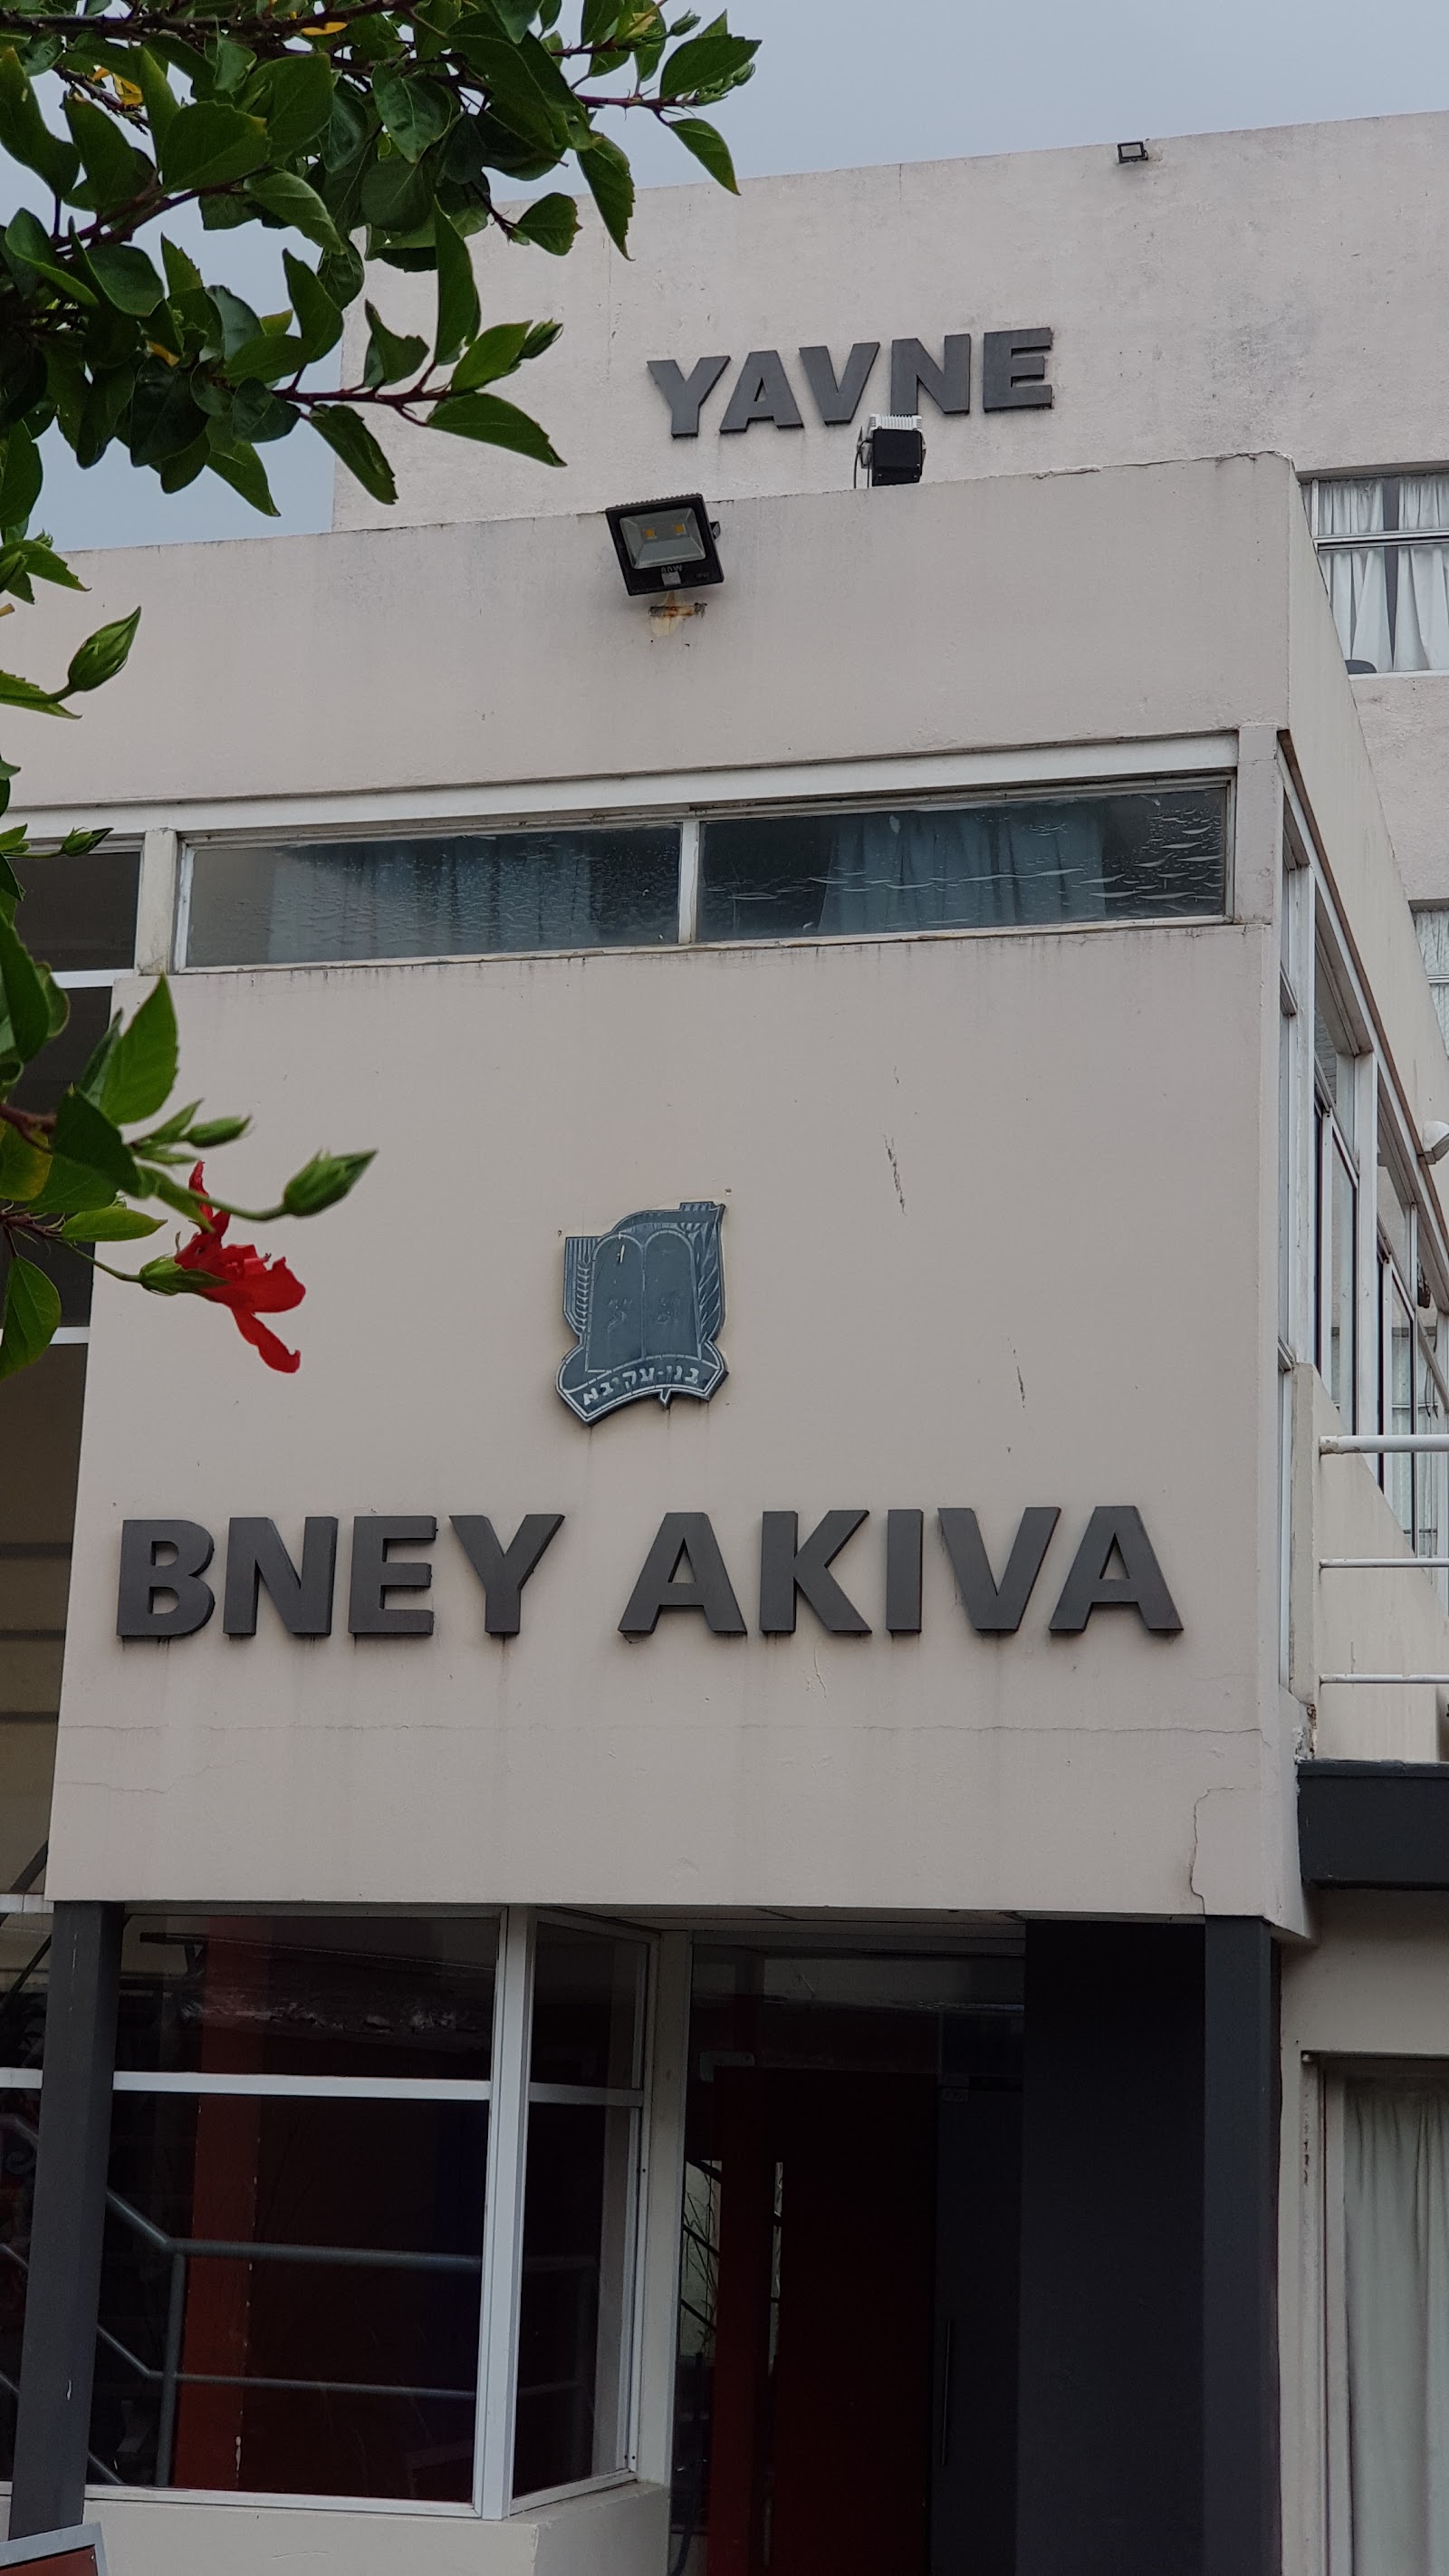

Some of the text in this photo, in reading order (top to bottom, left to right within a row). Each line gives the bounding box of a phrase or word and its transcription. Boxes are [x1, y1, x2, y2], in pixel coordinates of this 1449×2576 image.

[647, 327, 1053, 437] YAVNE
[117, 1505, 1184, 1637] BNEY AKIVA
